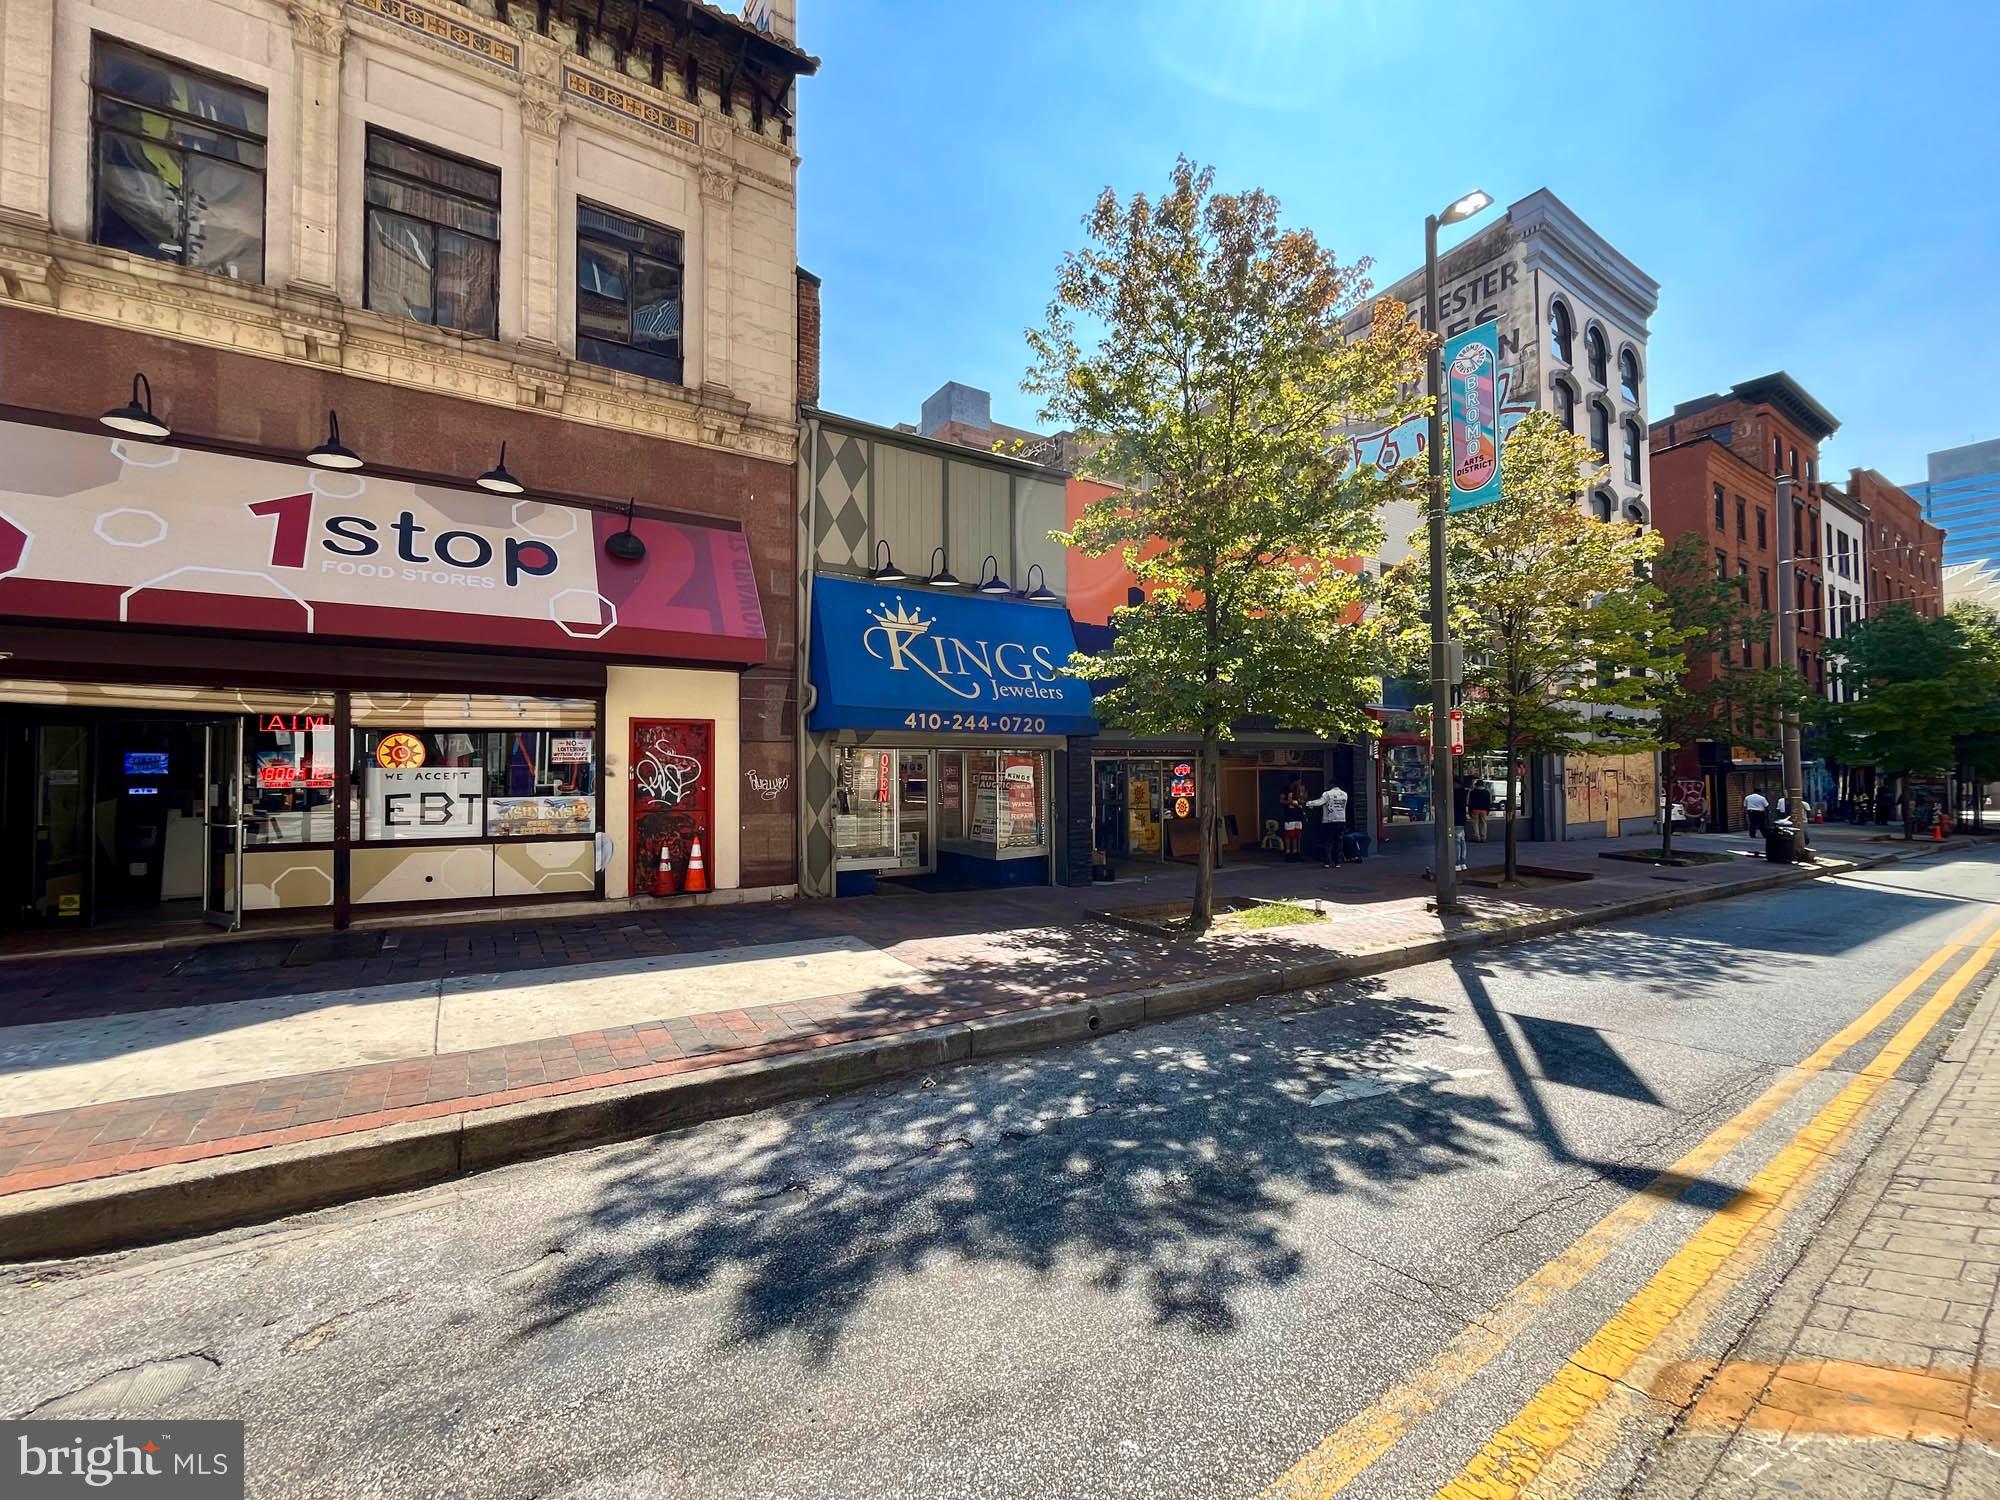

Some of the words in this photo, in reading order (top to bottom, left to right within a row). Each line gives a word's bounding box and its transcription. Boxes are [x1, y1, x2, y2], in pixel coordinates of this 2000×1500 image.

[1465, 375, 1480, 457] BROMO
[1456, 459, 1493, 477] DISTRICT
[1463, 454, 1485, 467] ARTS
[320, 510, 559, 588] stop
[320, 560, 396, 579] FOOD
[399, 564, 497, 589] STORES
[863, 625, 1057, 700] KINGS
[990, 678, 1064, 701] Jewelers
[903, 711, 1047, 733] 410-244-0720
[415, 772, 470, 781] ACCEPT
[881, 753, 890, 802] OPEN
[1007, 773, 1031, 781] KINGS
[384, 792, 482, 826] EBT
